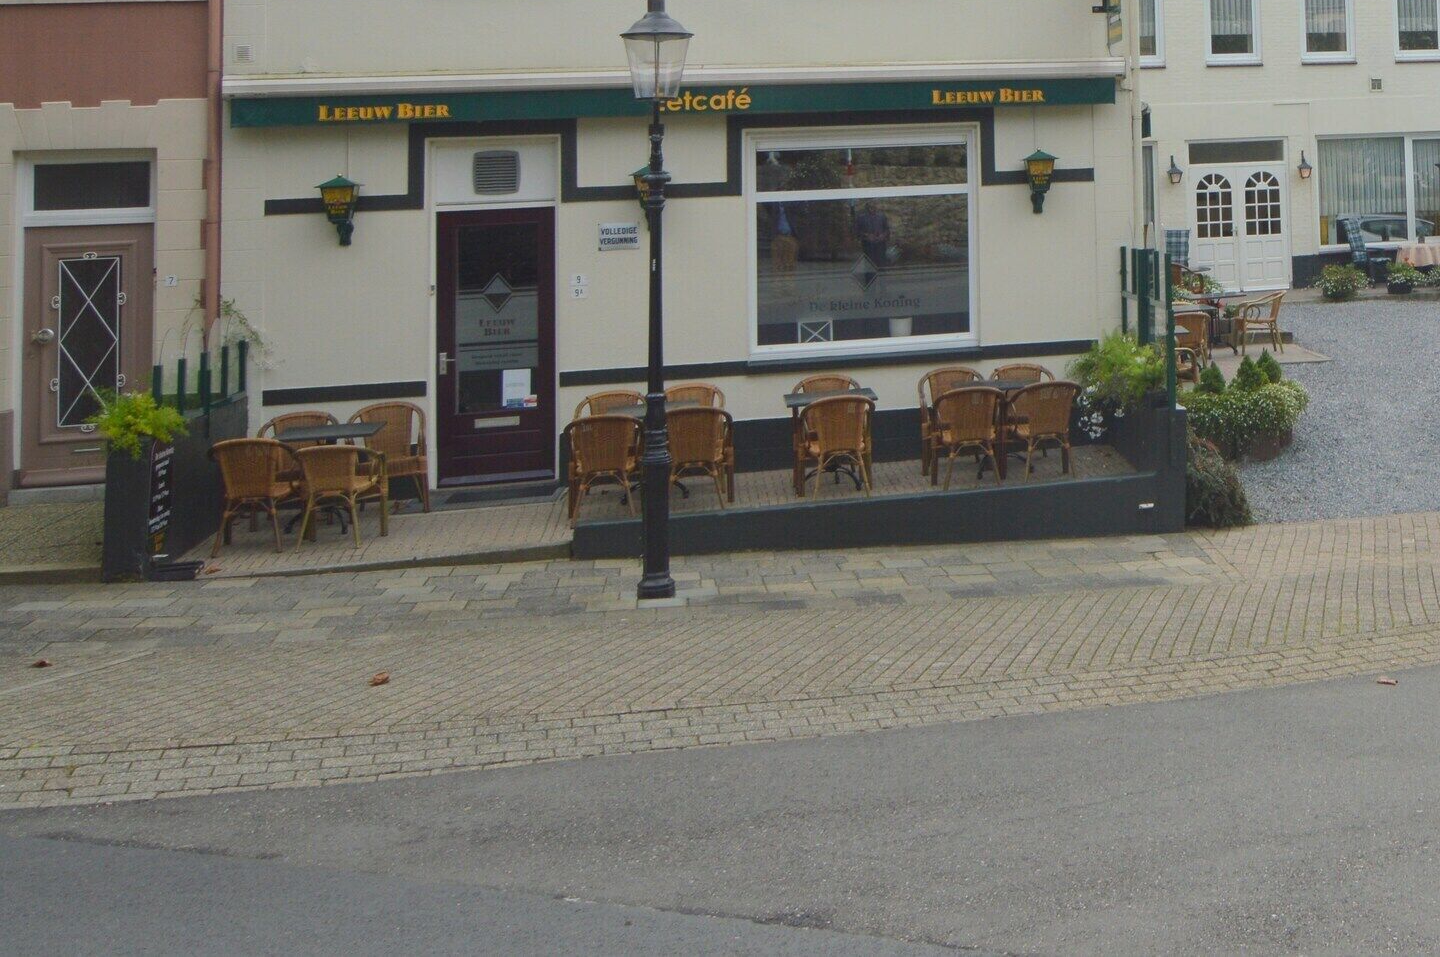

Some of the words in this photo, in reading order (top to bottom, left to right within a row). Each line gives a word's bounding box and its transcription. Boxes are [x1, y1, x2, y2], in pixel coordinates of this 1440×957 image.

[932, 90, 996, 104] LEEUW
[999, 88, 1045, 102] BIER
[318, 105, 393, 121] LEEUW
[397, 103, 450, 119] BIER
[601, 226, 638, 236] VOLLEDIGE
[600, 236, 638, 245] VERGUNNING
[576, 275, 582, 284] 9
[874, 295, 920, 309] Koning
